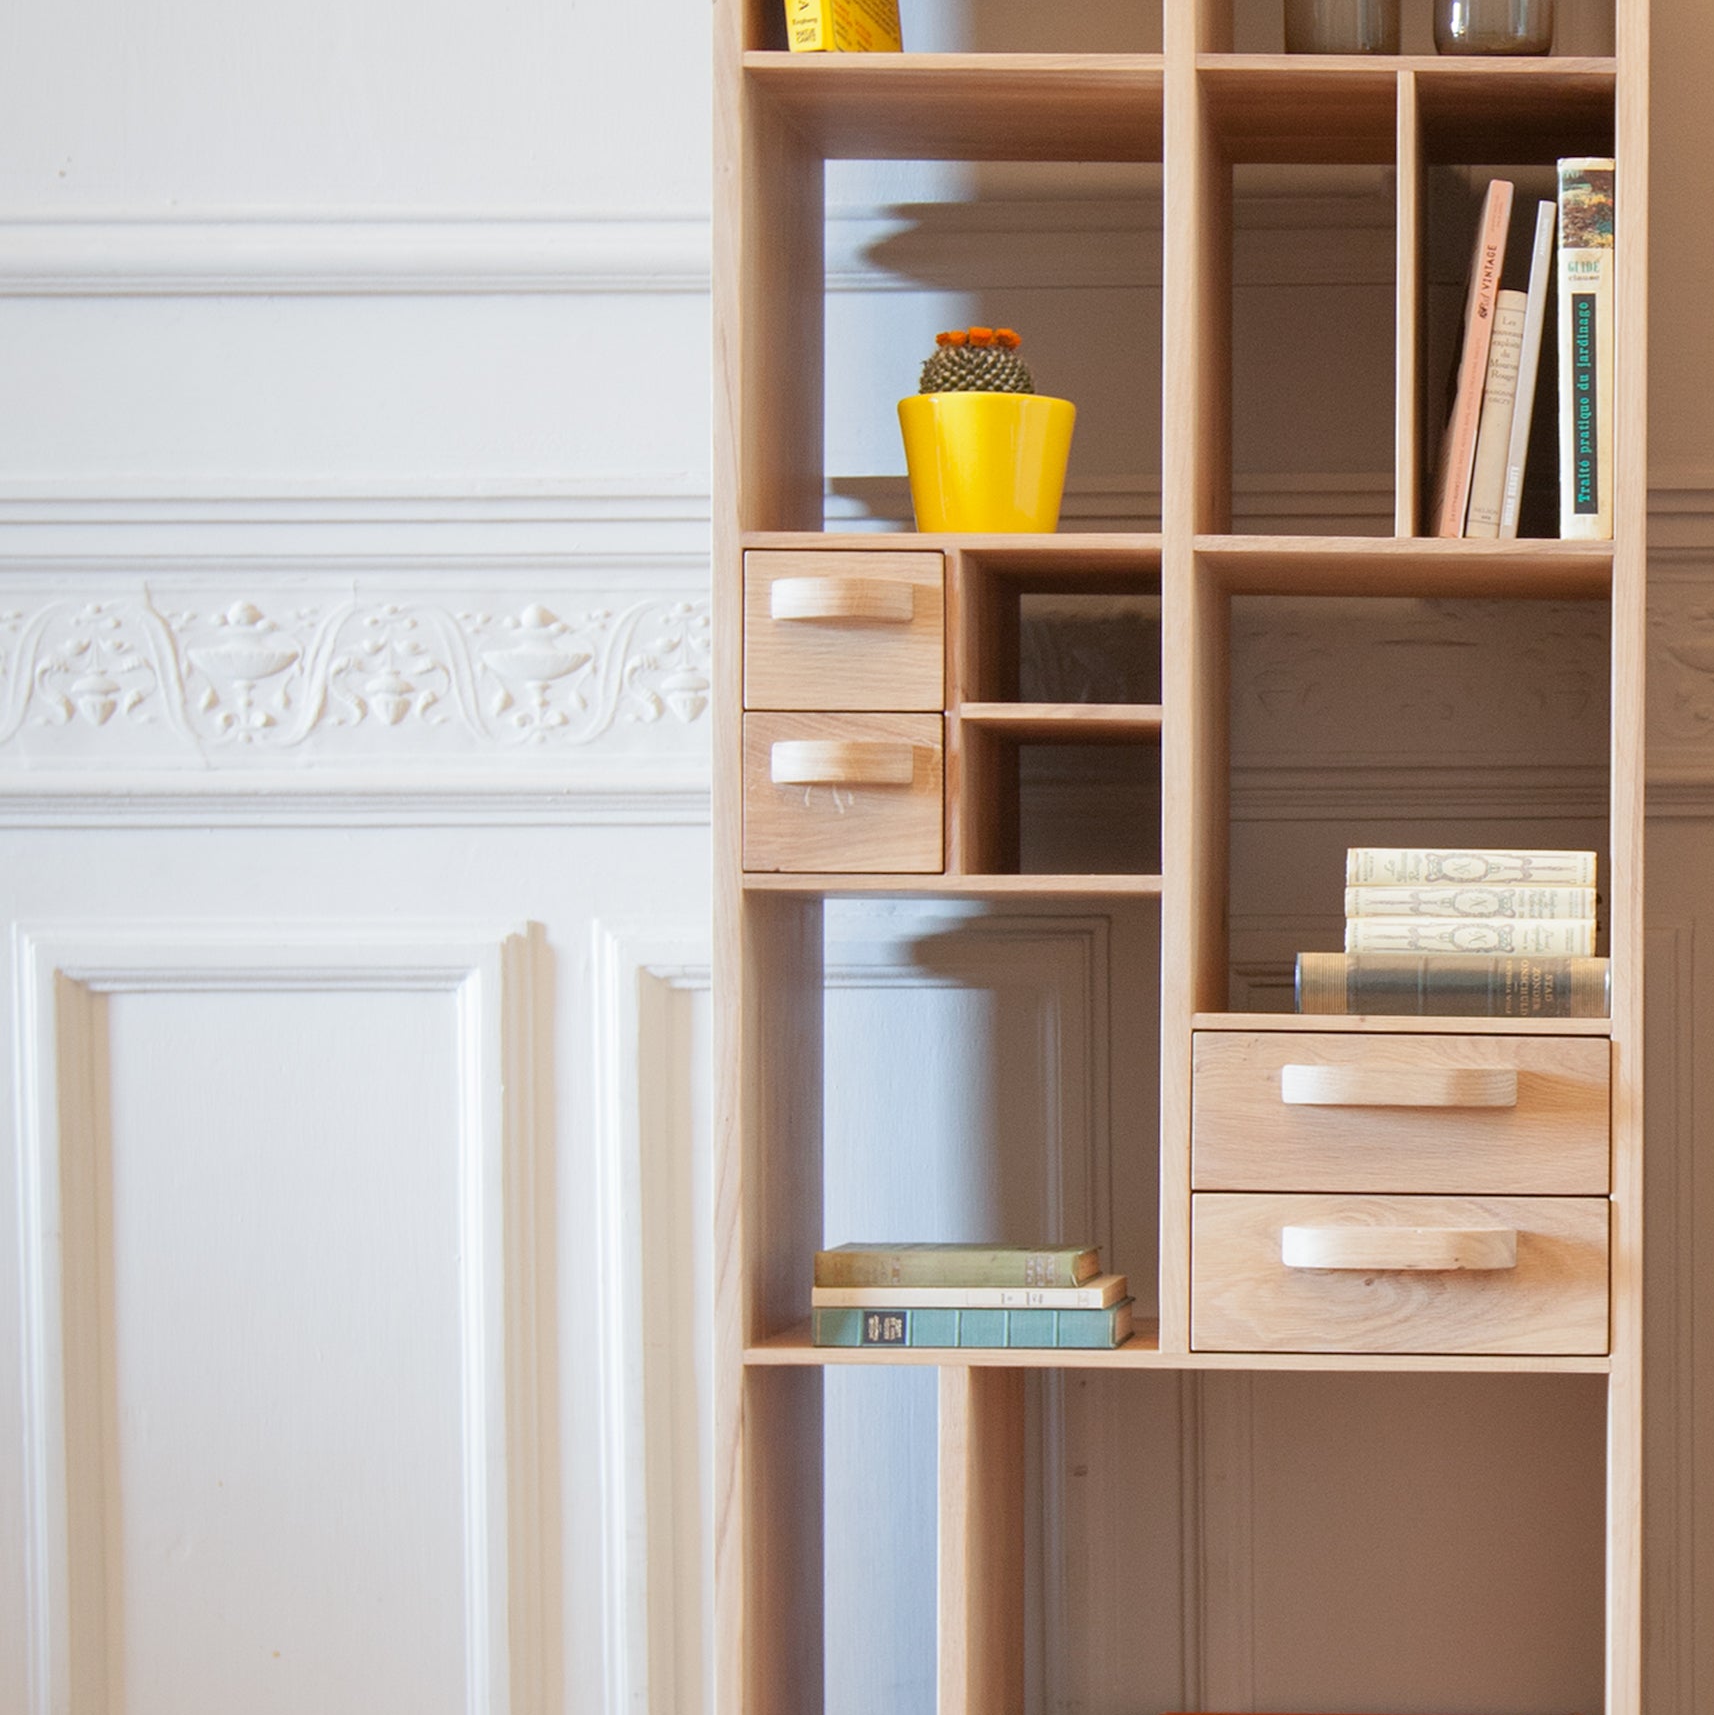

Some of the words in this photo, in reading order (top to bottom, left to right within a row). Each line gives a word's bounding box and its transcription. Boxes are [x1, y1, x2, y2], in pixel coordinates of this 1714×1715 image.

[1481, 244, 1498, 289] VINTAGE
[1567, 260, 1600, 273] GUIDE
[1577, 372, 1590, 391] du
[1544, 973, 1554, 1003] STAD
